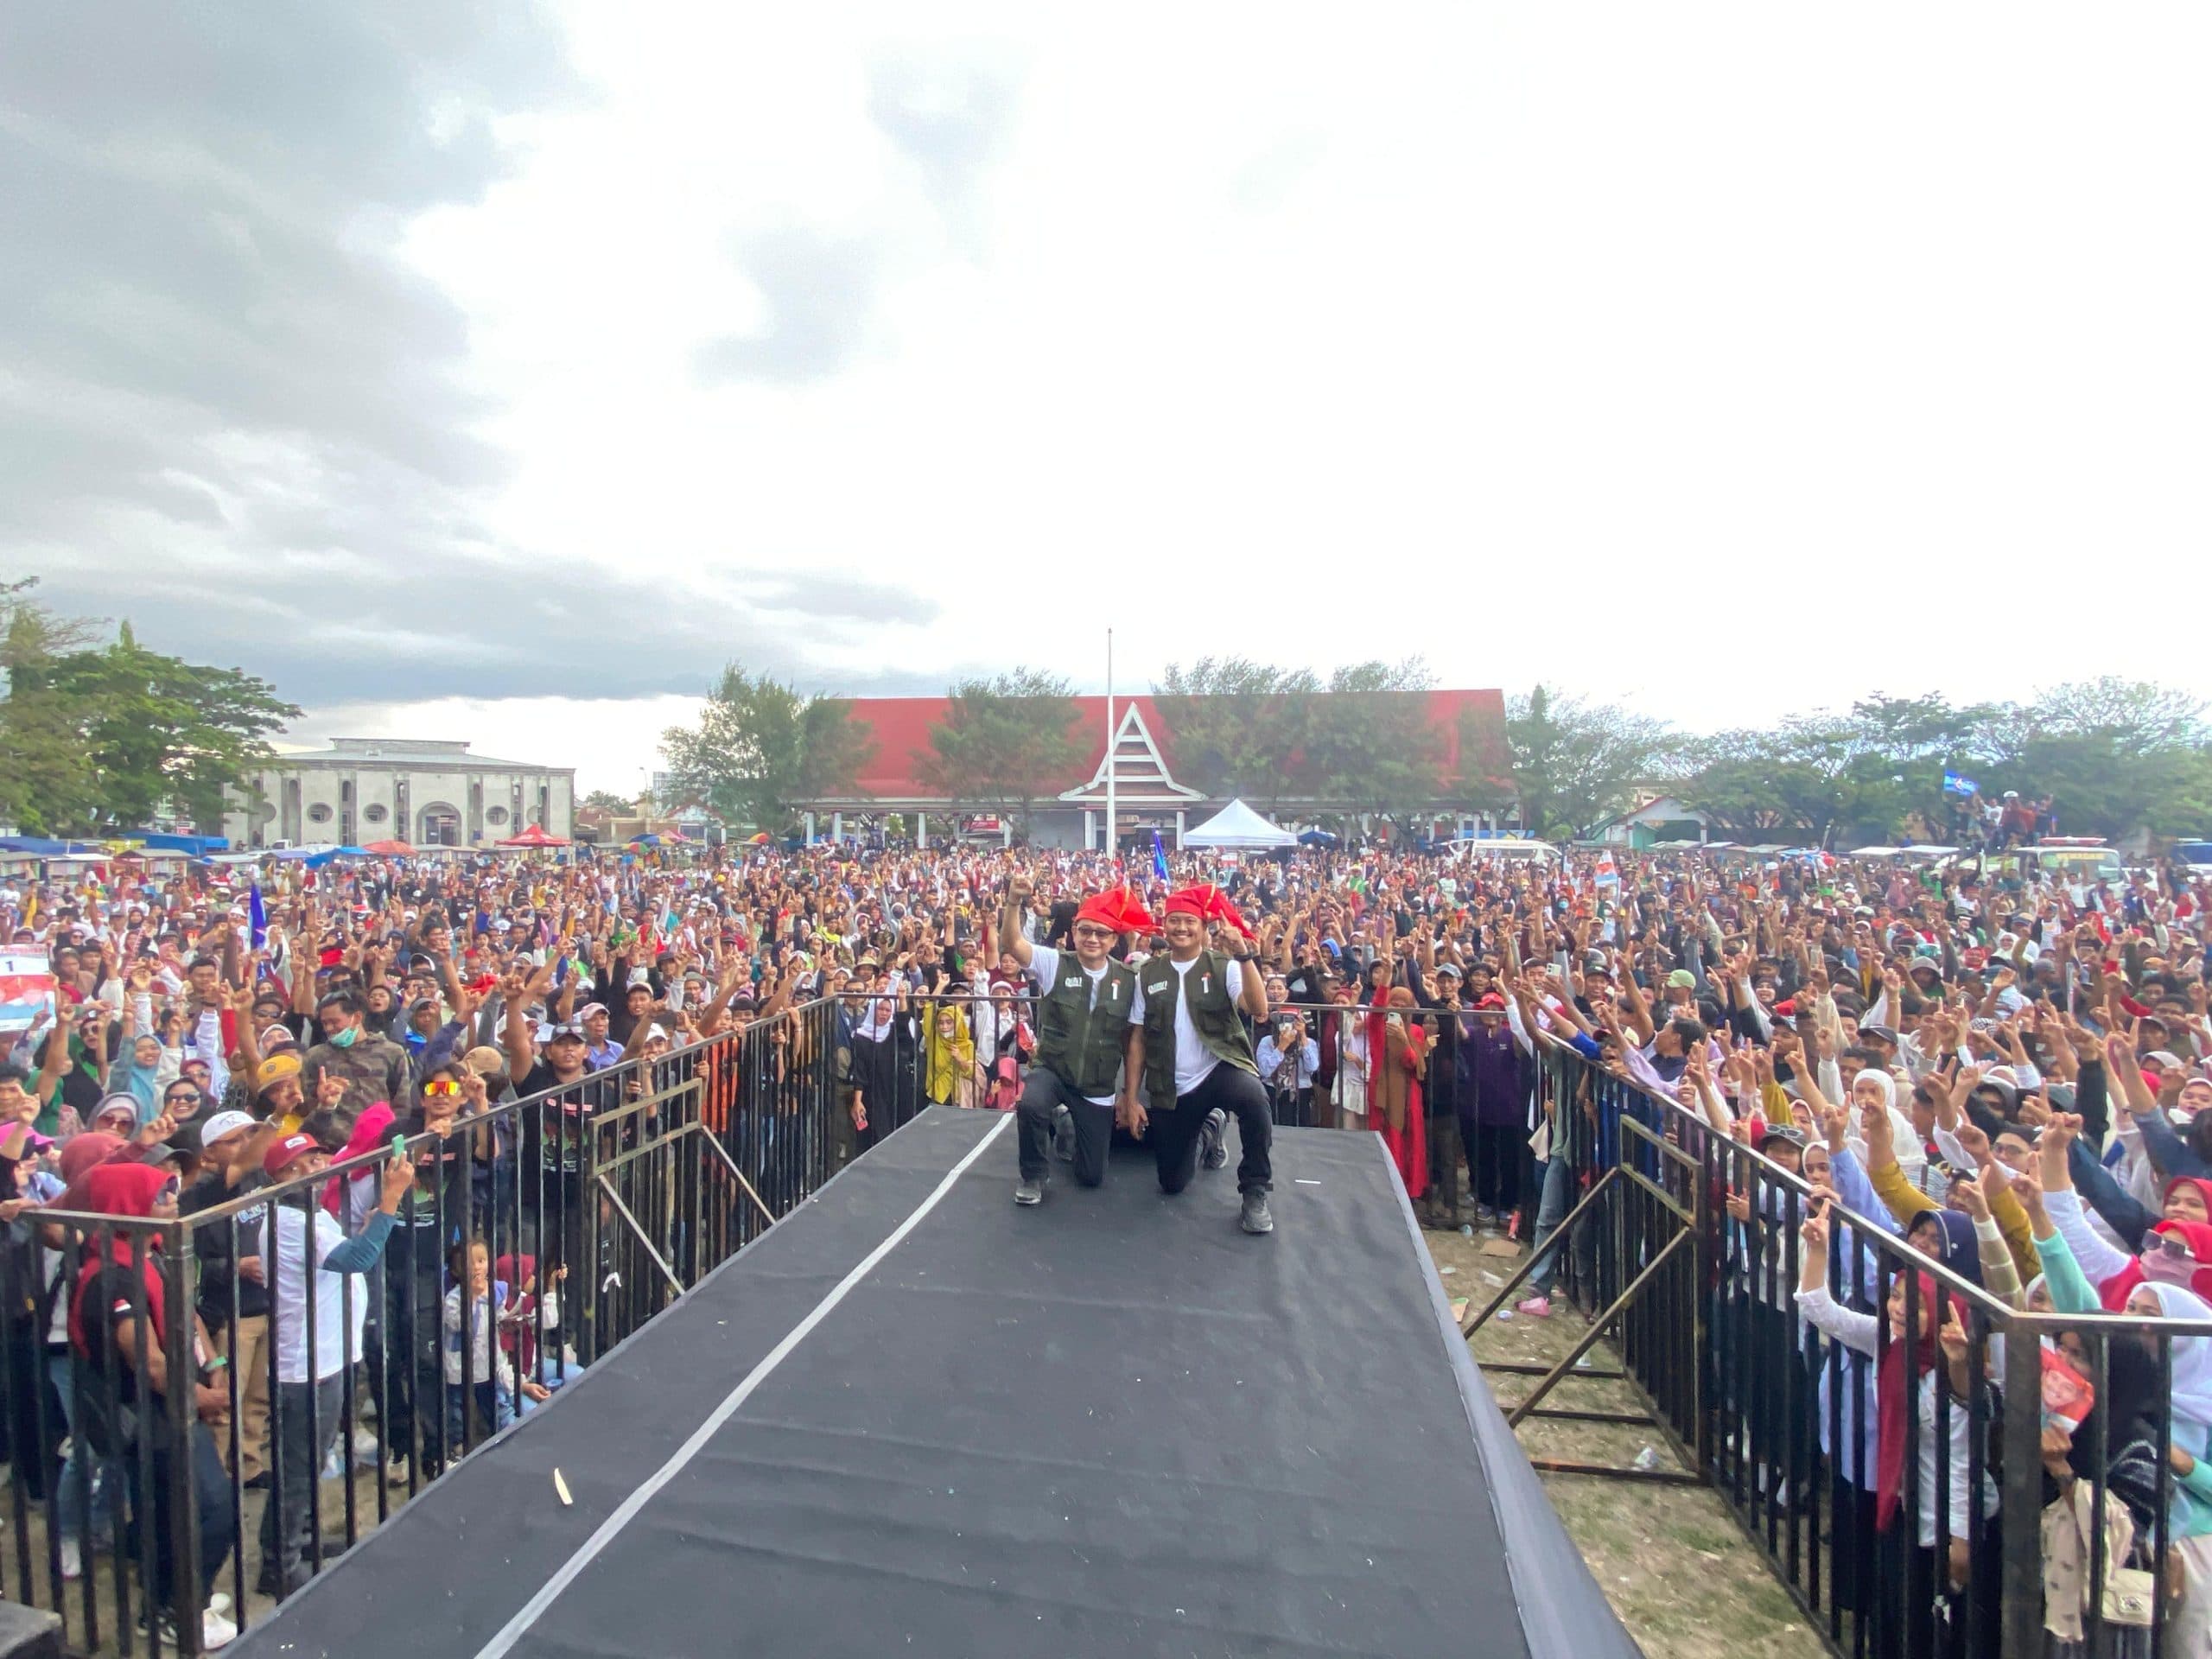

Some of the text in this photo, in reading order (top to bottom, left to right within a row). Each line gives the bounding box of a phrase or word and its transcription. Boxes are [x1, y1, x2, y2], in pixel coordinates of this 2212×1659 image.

[5, 960, 14, 972] 1
[1111, 981, 1119, 1000] 1
[1201, 976, 1209, 994] 1
